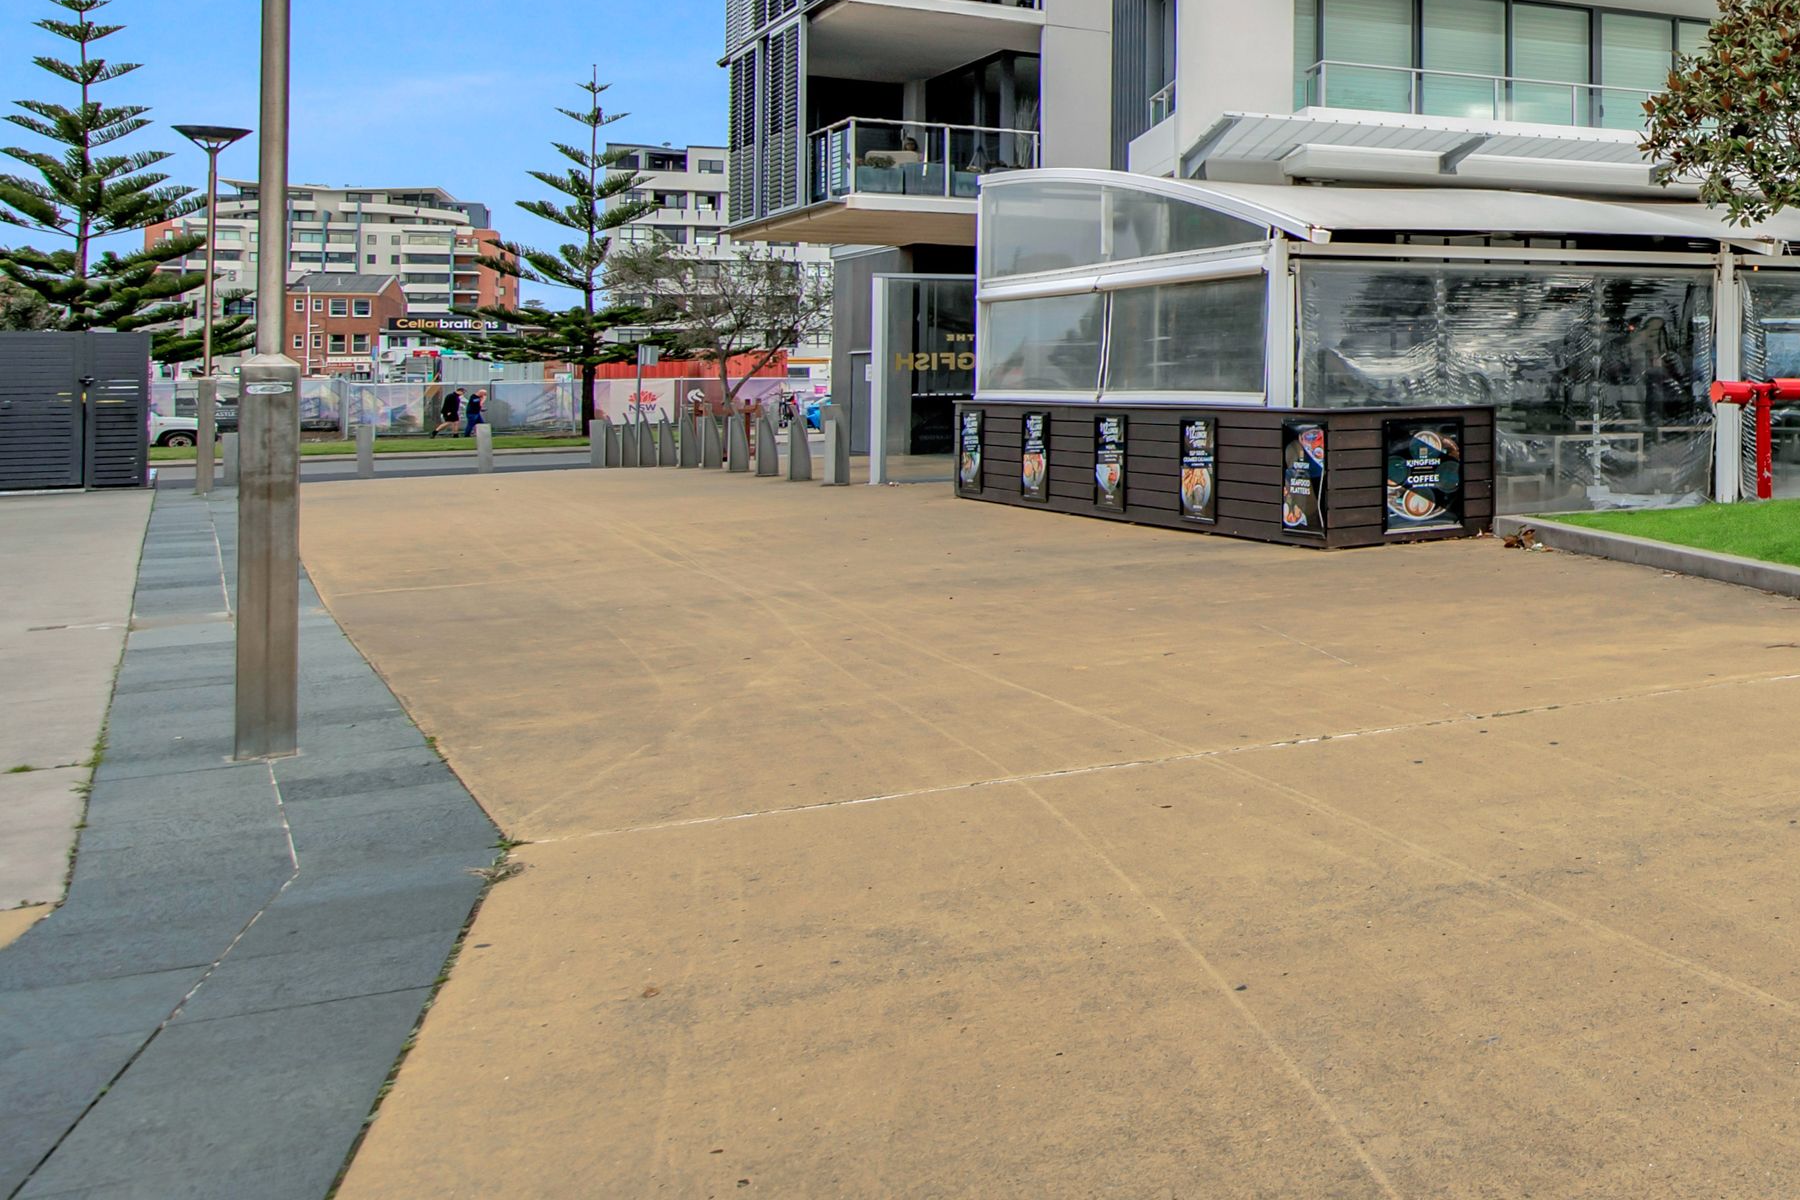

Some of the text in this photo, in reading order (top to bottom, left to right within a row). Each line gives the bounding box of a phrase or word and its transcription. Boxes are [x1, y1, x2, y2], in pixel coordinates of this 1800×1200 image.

[396, 318, 499, 330] Cellarbrations
[628, 403, 656, 411] NSW
[1406, 458, 1441, 467] KINGFISH
[1290, 478, 1311, 488] SEAFOOD
[1407, 474, 1440, 484] COFFEE
